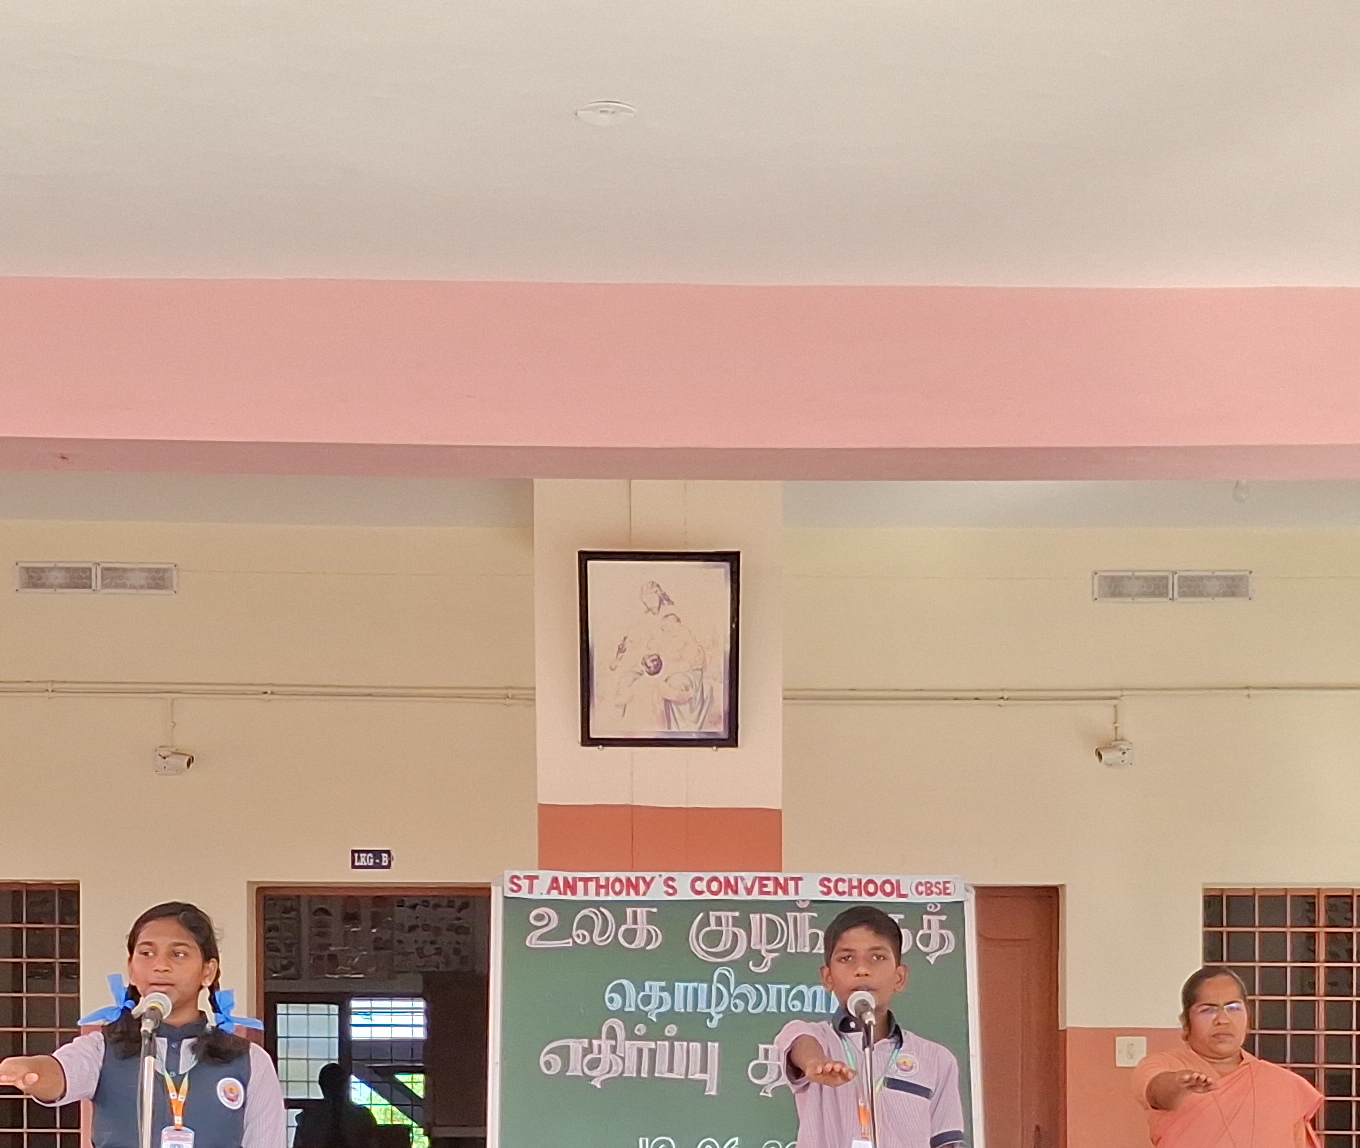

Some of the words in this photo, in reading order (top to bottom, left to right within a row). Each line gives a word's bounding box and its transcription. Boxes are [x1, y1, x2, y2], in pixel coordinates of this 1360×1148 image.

[690, 876, 804, 897] CONVENT
[819, 877, 908, 898] SCHOOL
[525, 906, 663, 950] உலக
[604, 966, 840, 1029] தொழிலாள
[540, 1018, 720, 1096] எதிர்ப்பு
